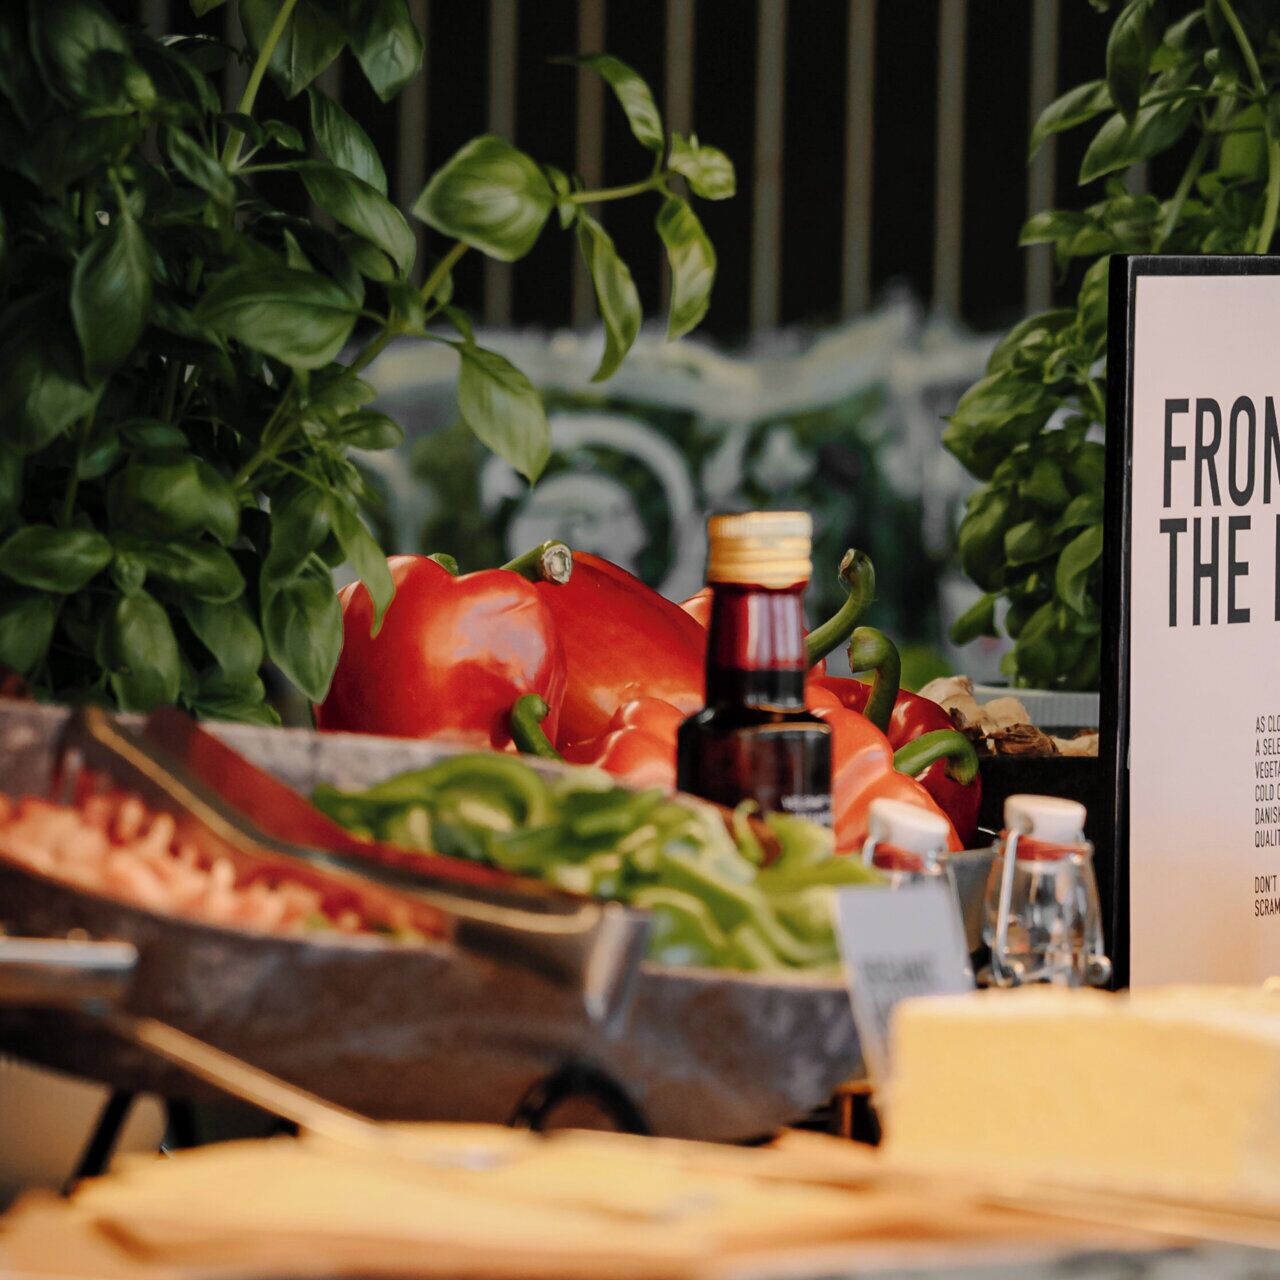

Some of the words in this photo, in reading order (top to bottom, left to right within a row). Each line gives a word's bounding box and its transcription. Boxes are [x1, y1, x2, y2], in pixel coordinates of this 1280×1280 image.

[1159, 515, 1252, 627] THE
[1255, 715, 1265, 733] AS
[1255, 739, 1260, 756] A
[1255, 783, 1274, 802] COLD
[1254, 874, 1277, 894] DON'T
